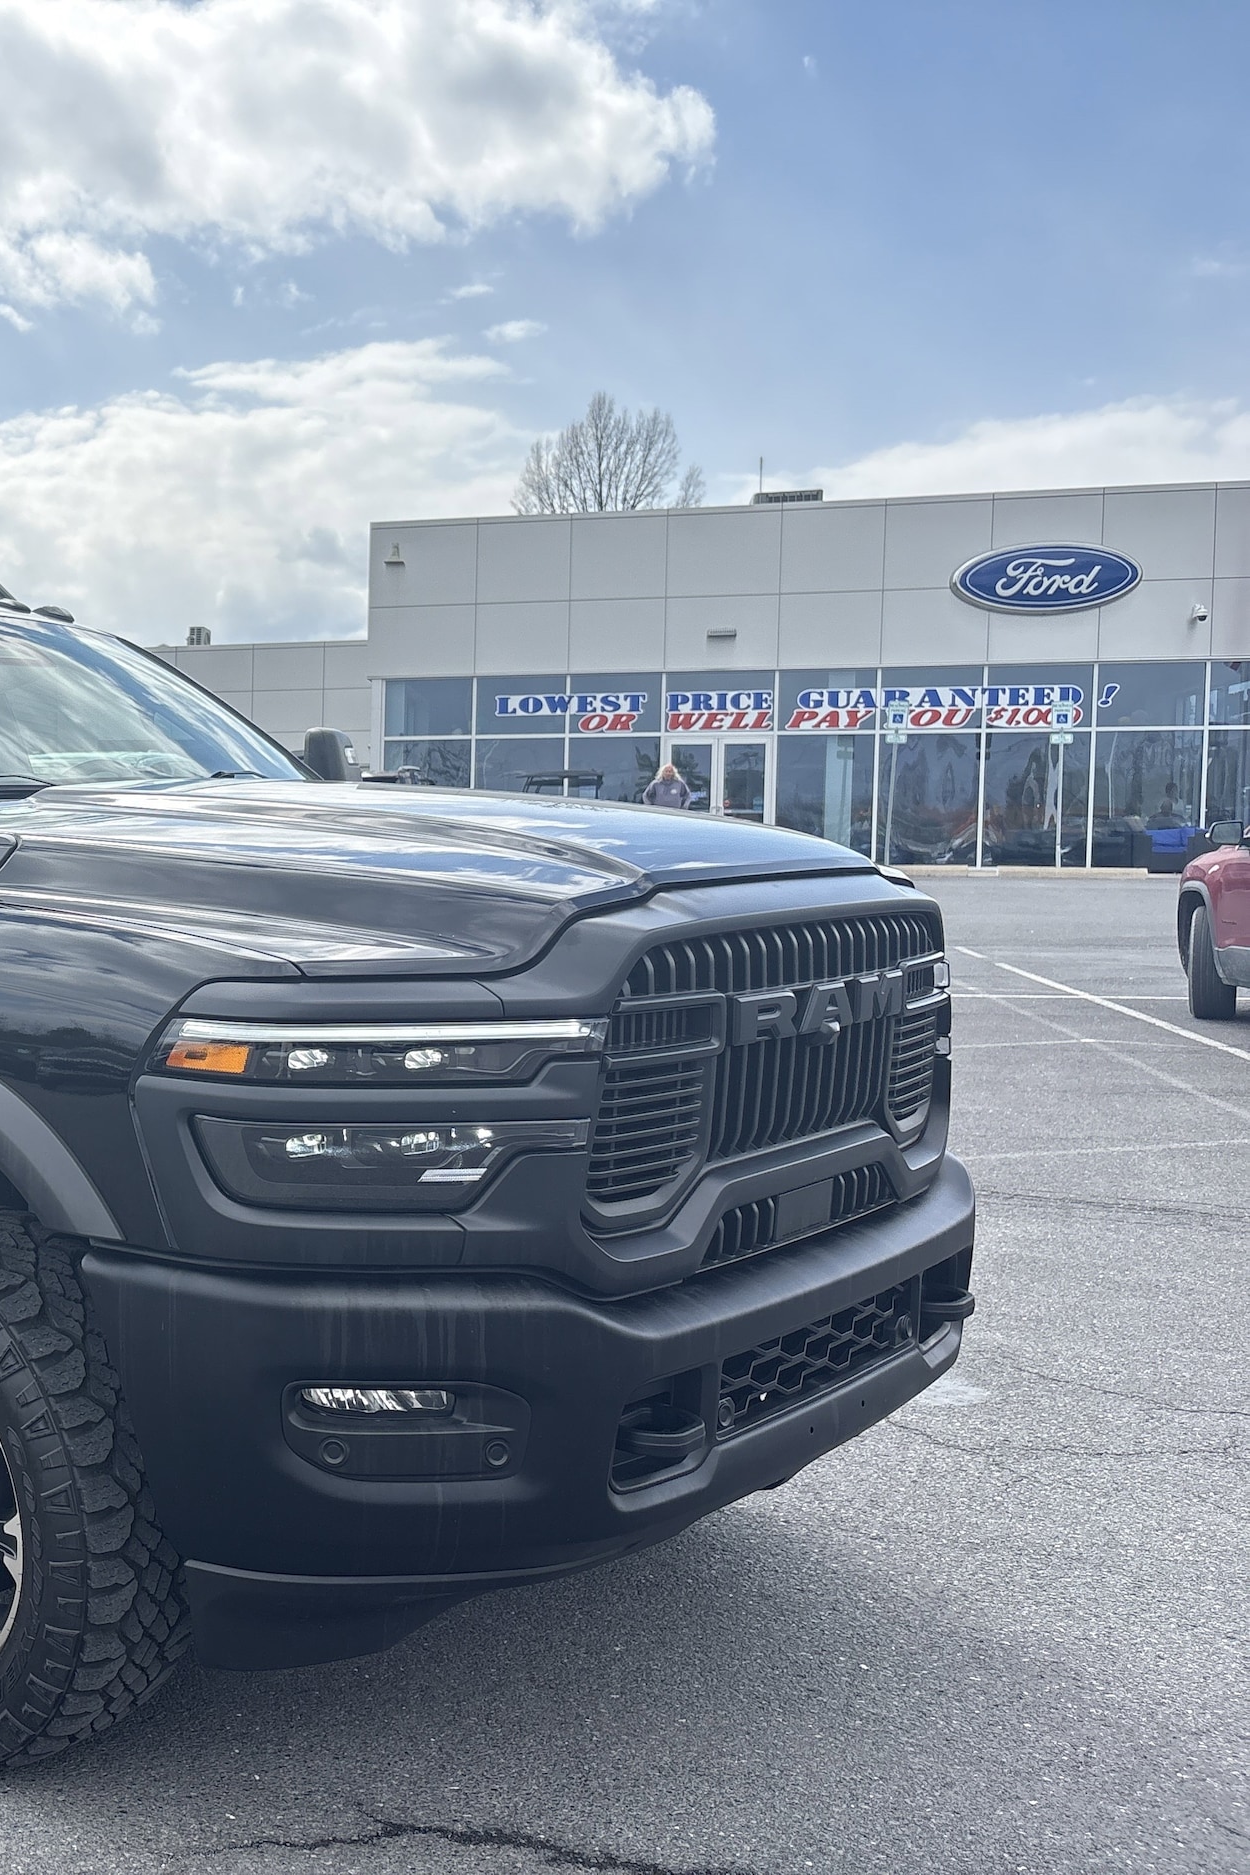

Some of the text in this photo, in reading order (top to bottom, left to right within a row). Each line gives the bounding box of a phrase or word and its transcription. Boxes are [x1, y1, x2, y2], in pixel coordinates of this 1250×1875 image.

[995, 558, 1102, 597] Ford
[496, 693, 646, 715] LOWEST
[667, 691, 773, 712] PRICE
[579, 713, 638, 732] OR
[786, 709, 874, 729] PAY
[732, 970, 904, 1047] RAM
